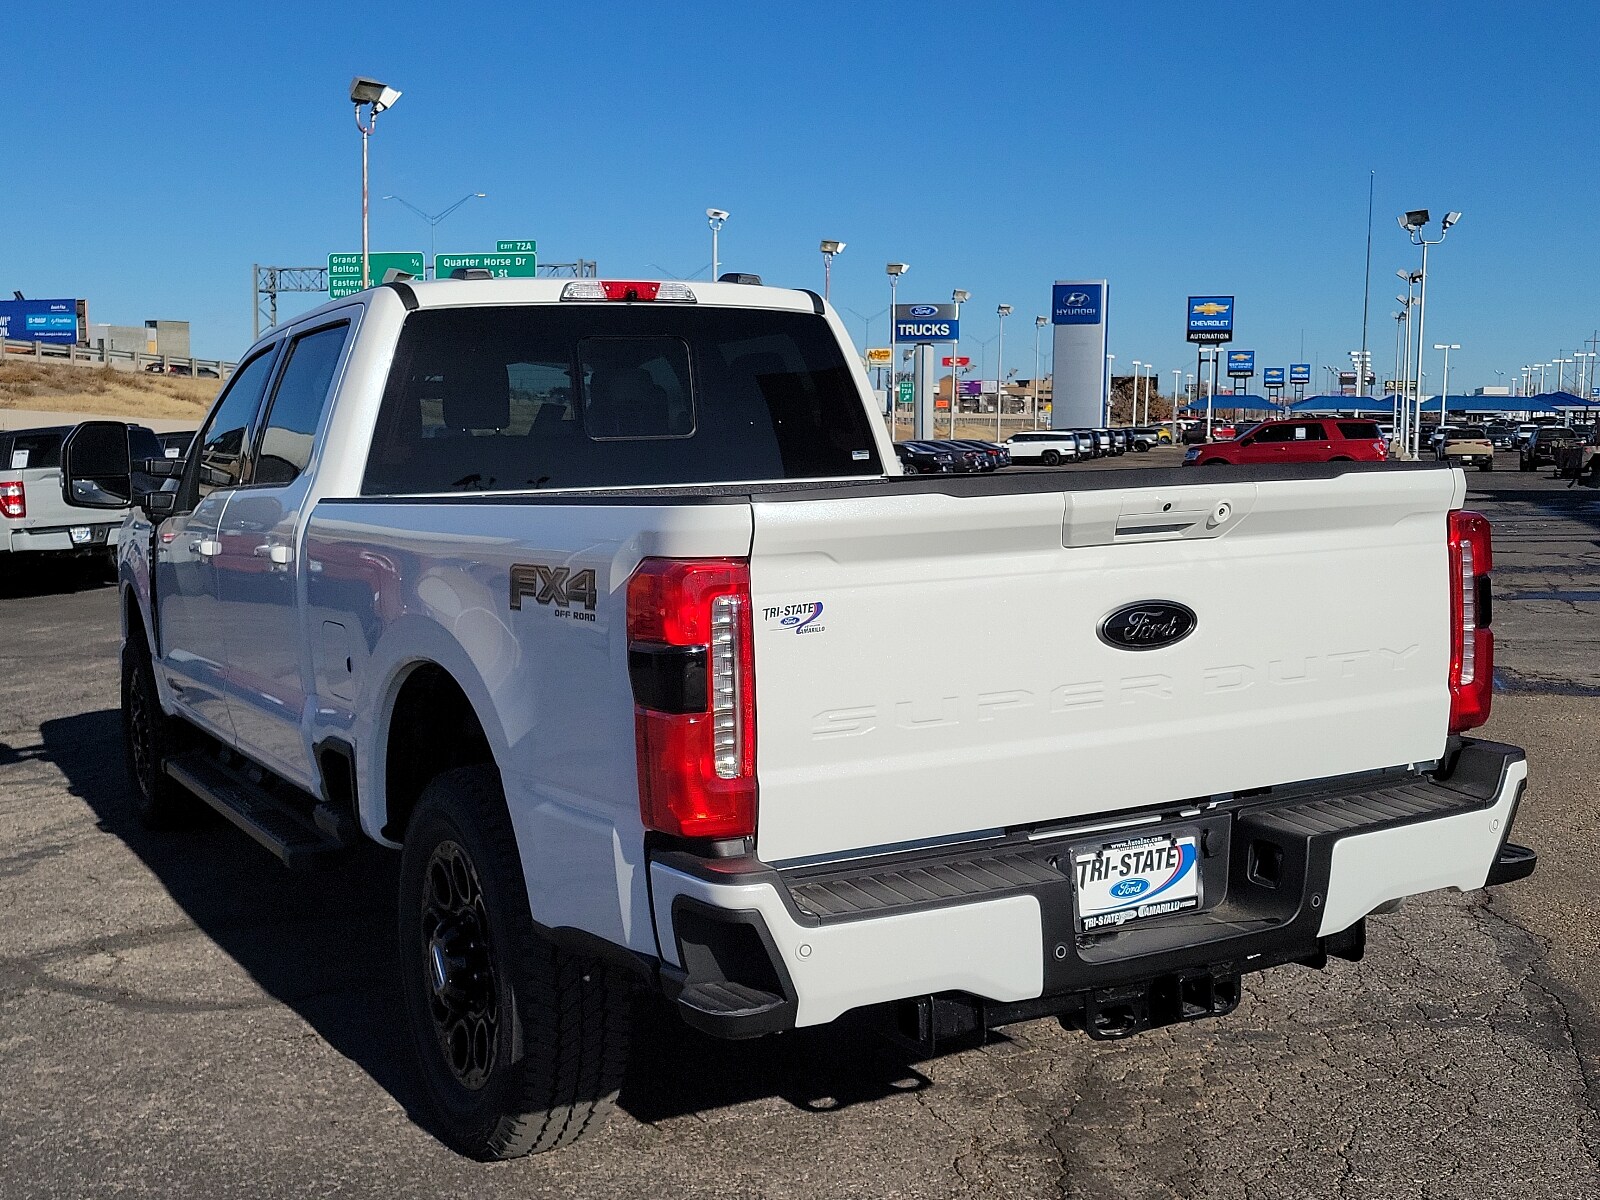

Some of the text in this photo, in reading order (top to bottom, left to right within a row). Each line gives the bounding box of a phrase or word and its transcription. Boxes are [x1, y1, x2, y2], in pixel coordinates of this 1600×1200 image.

[516, 242, 532, 250] 72A
[332, 255, 357, 264] Grand
[443, 257, 527, 267] Quarter Horse Dr
[332, 265, 360, 273] Bolton
[498, 269, 509, 278] St
[332, 278, 363, 287] Eastern
[1056, 308, 1096, 316] HYUNDAI
[897, 323, 950, 336] TRUCKS
[510, 563, 597, 611] FX4
[554, 609, 596, 622] OFF ROAD
[762, 602, 815, 621] TRI-STATE
[1124, 610, 1178, 641] Ford
[811, 643, 1421, 741] SUPER DUTY
[1076, 846, 1177, 890] TRI-STATE
[1118, 881, 1142, 896] Ford
[1083, 912, 1121, 932] TRI-STATE
